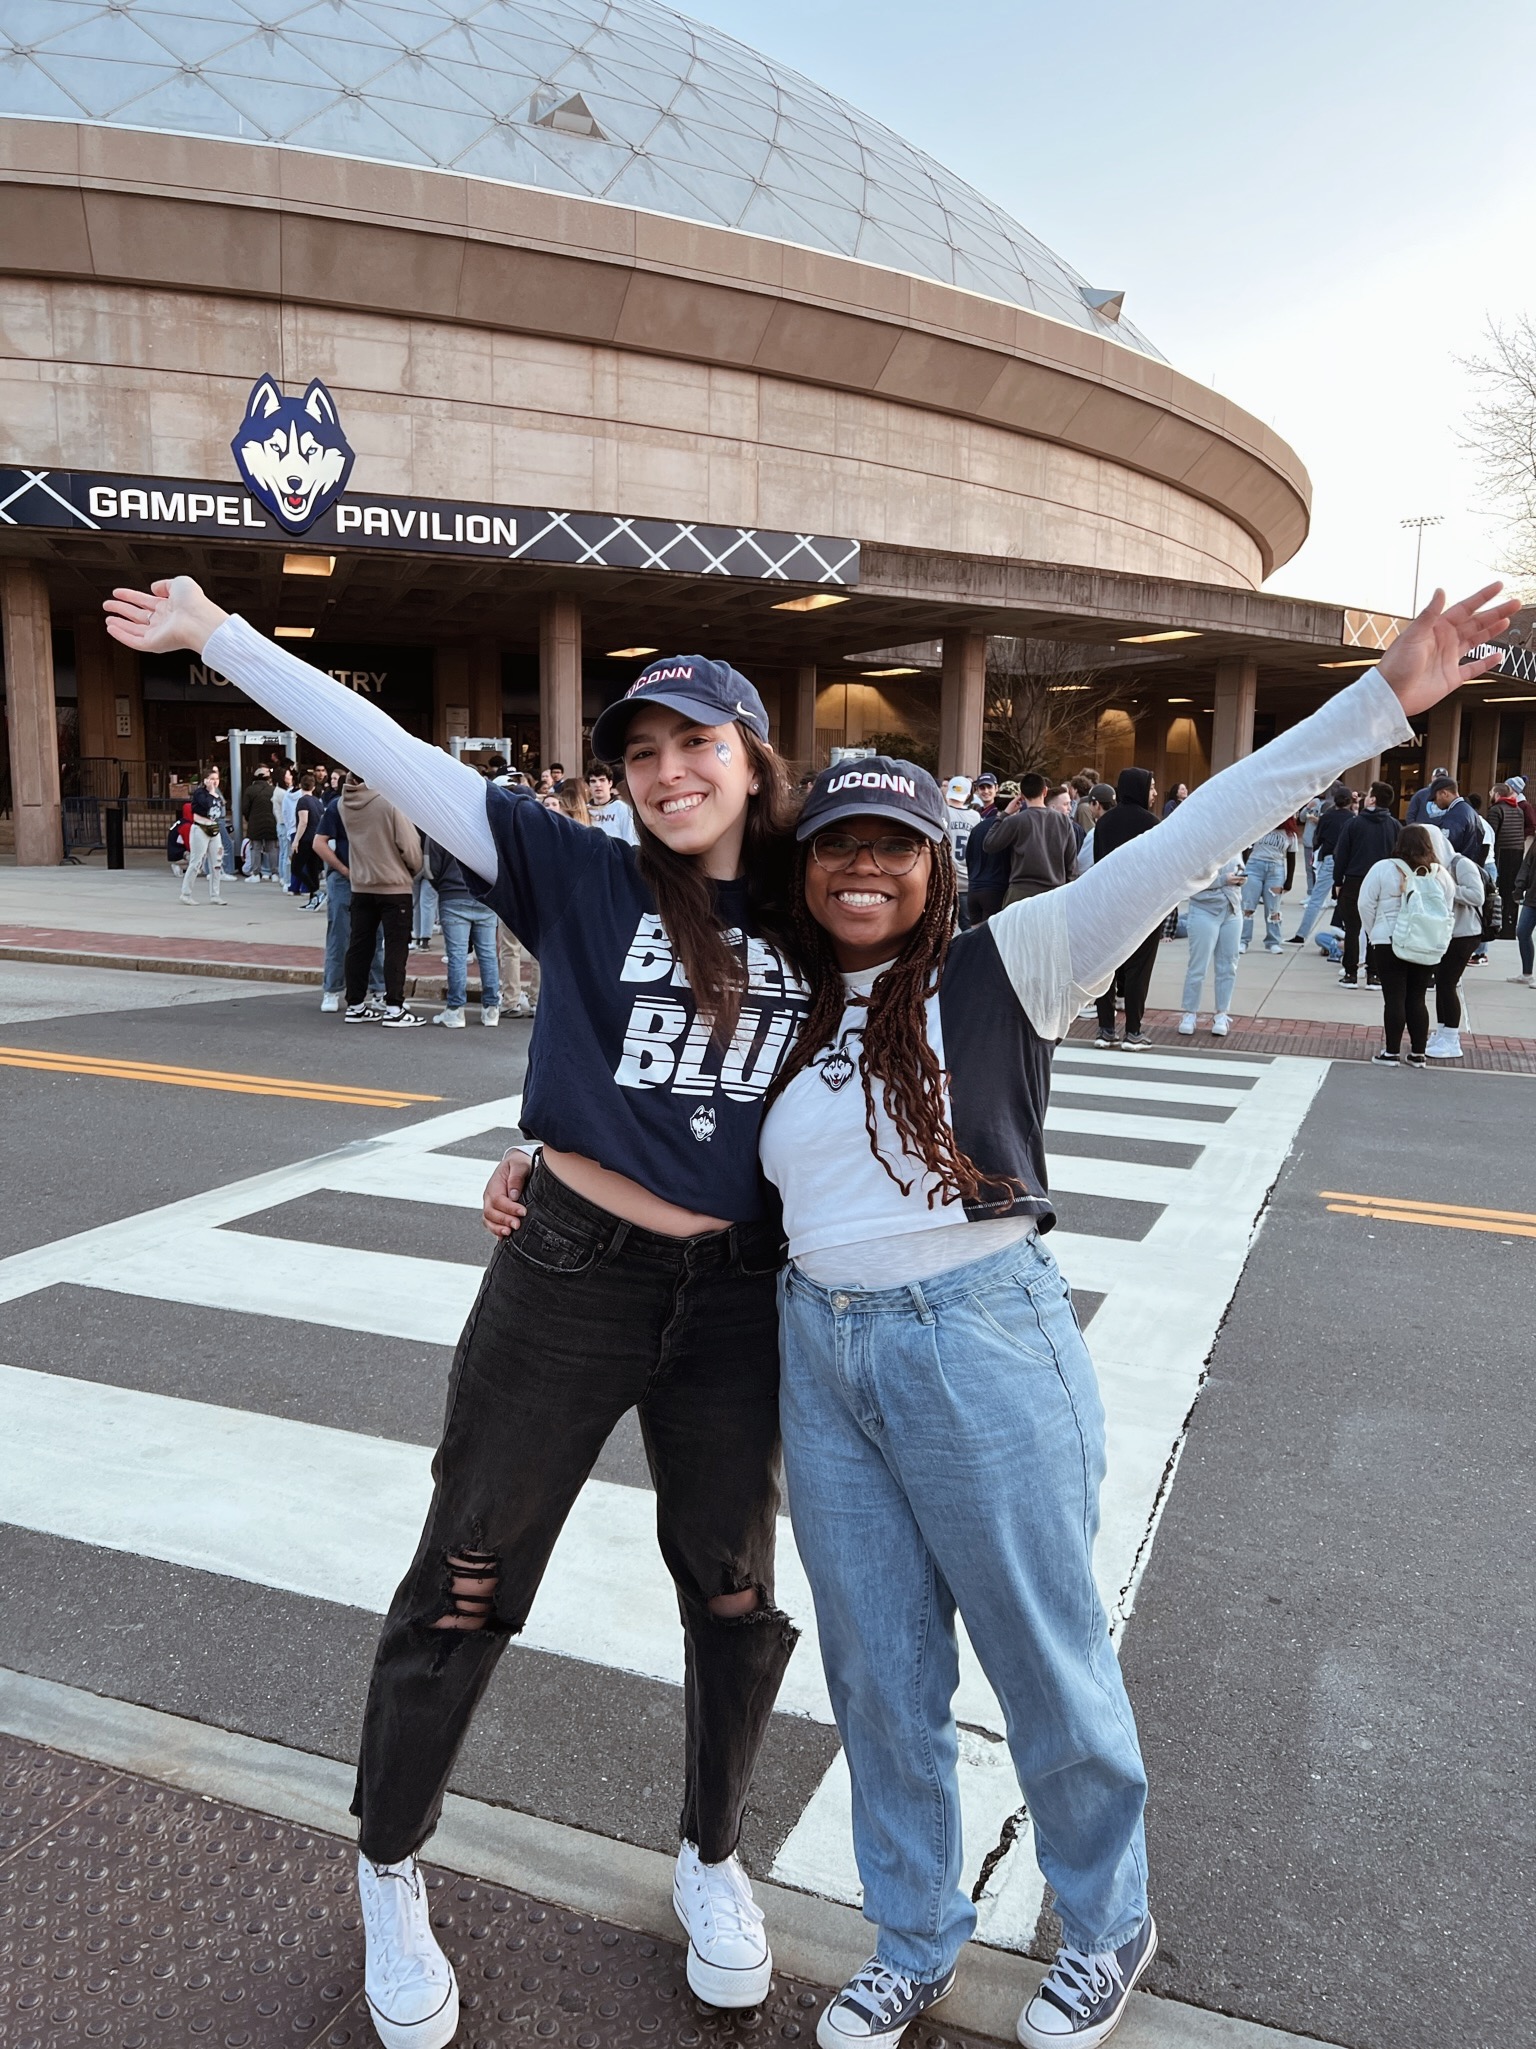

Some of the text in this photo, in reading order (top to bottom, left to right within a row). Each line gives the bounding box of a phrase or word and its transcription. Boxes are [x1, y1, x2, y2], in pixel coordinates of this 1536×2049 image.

[88, 486, 517, 546] GAMPEL PAVILION
[624, 666, 693, 699] UCONN
[827, 771, 916, 798] UCONN
[594, 814, 615, 822] ONN
